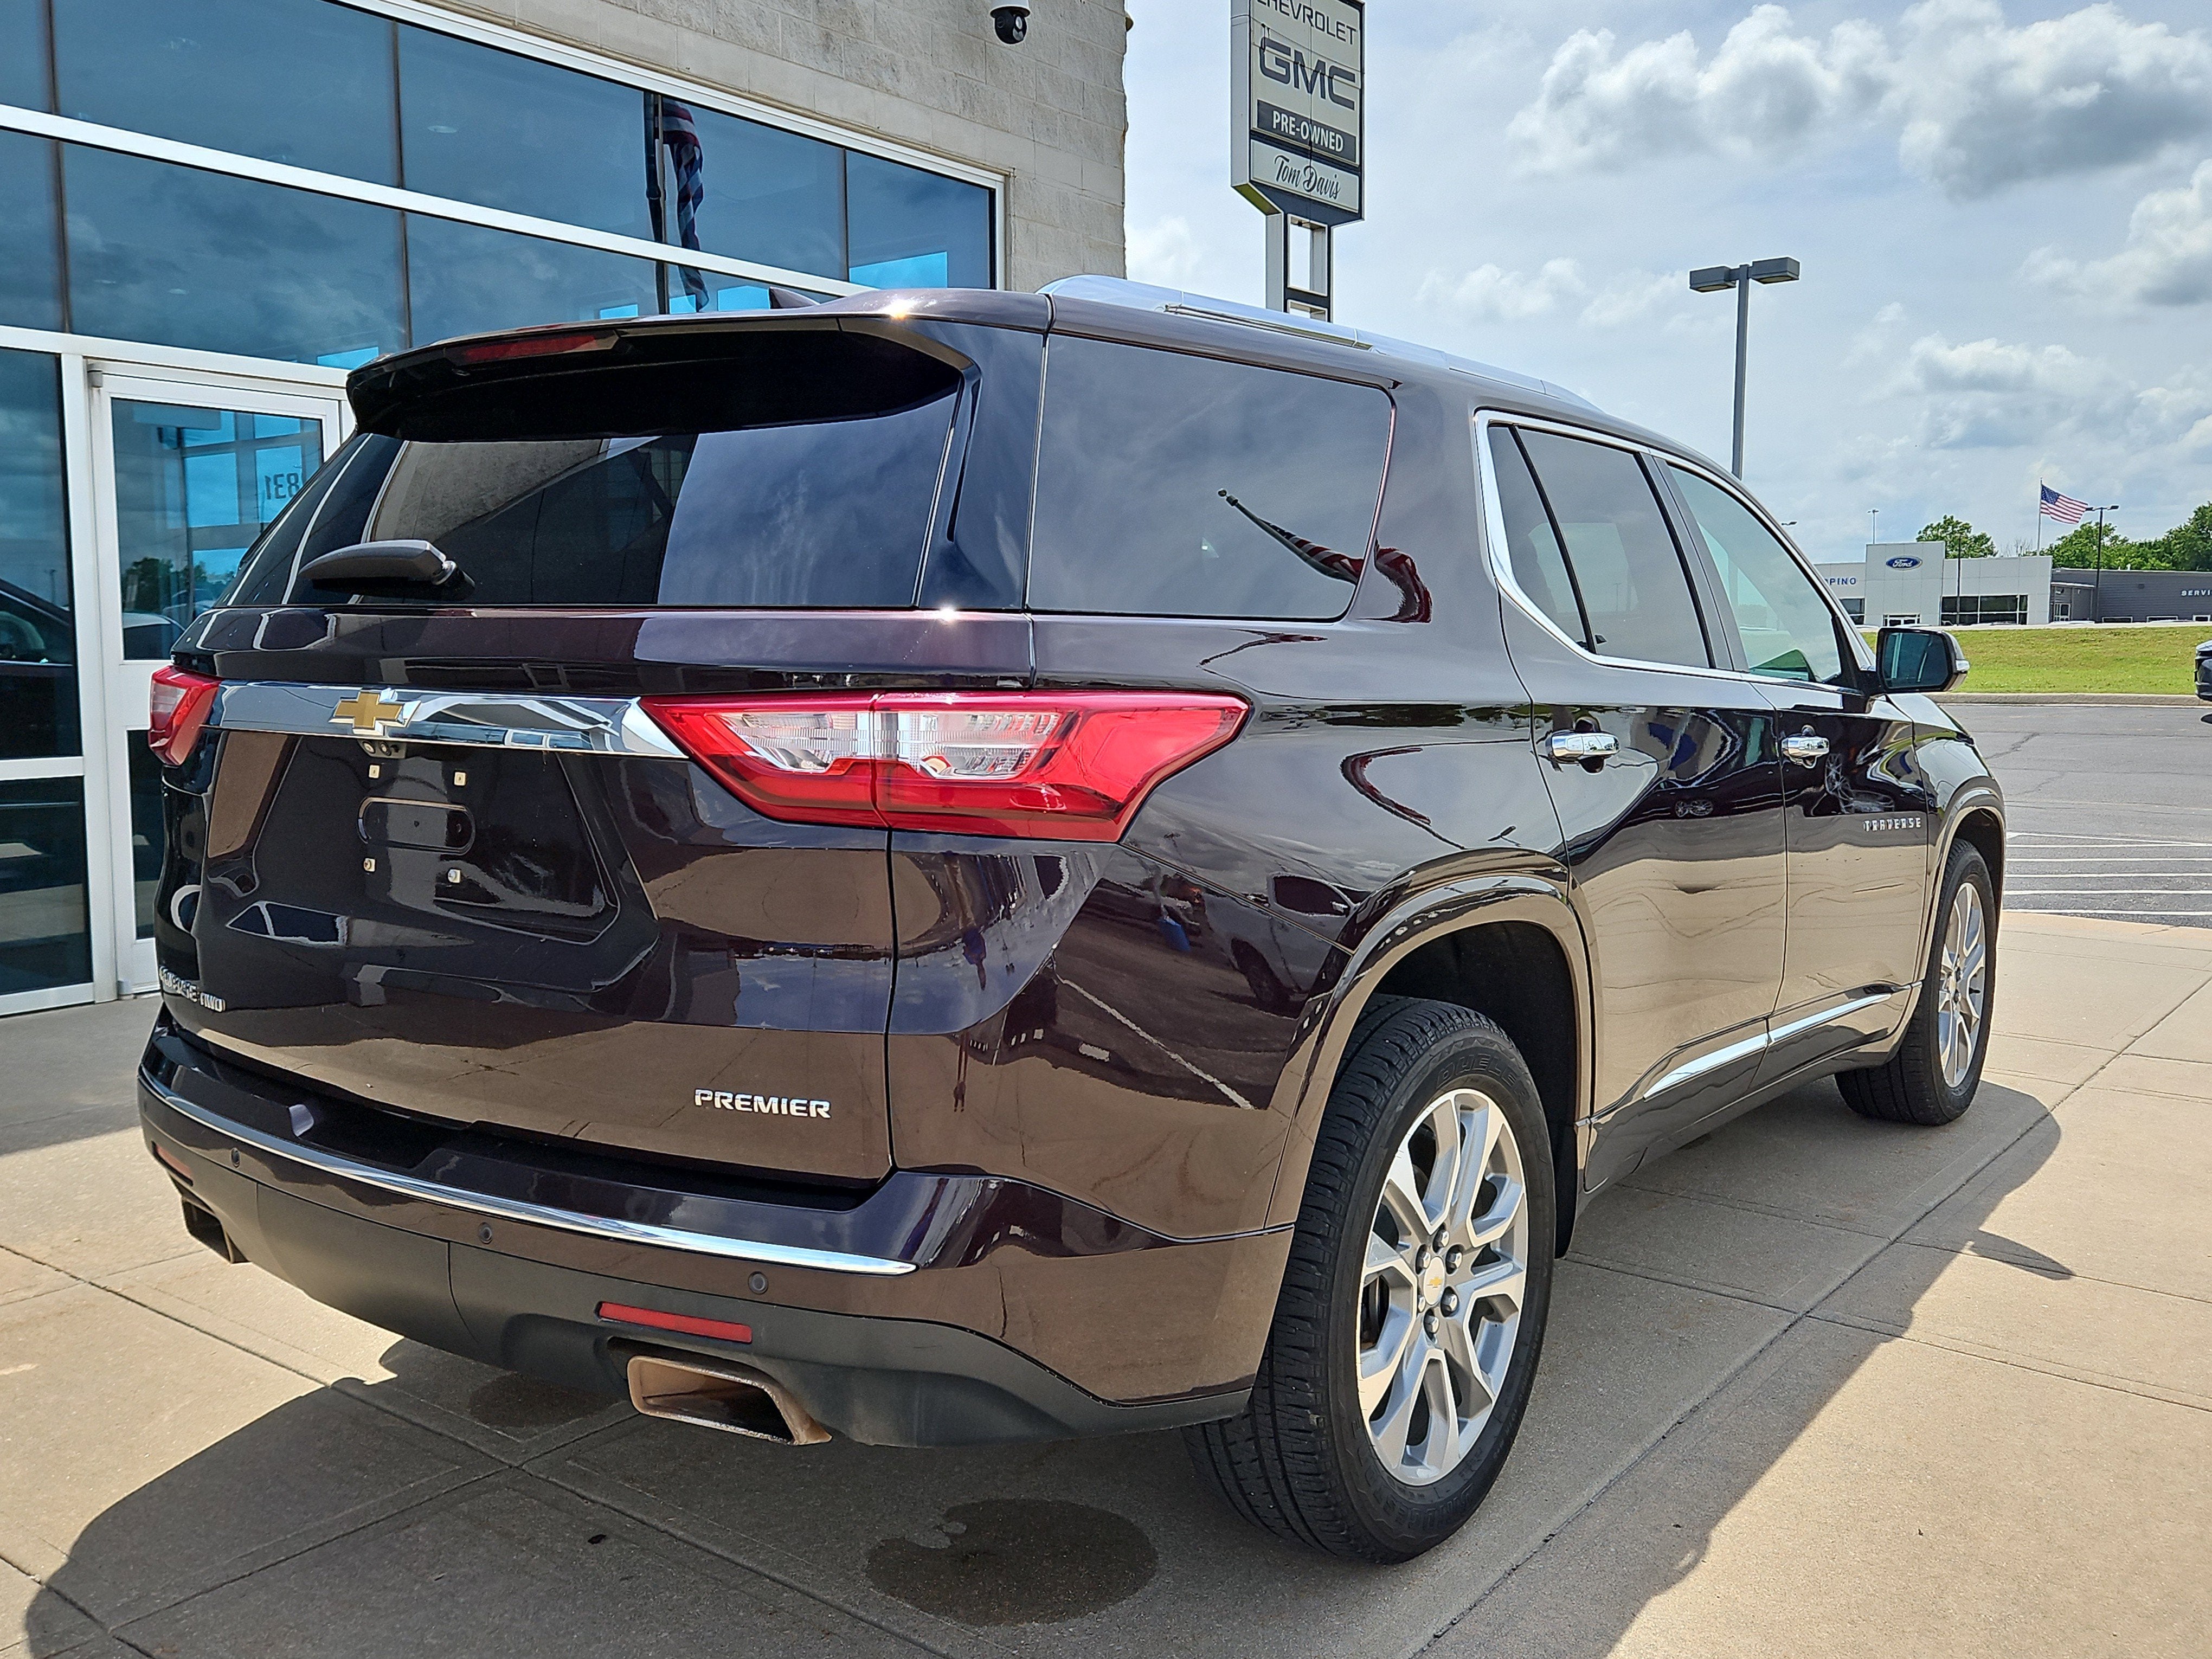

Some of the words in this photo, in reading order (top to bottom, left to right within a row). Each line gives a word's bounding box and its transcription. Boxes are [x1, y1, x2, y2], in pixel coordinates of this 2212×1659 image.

[1256, 0, 1356, 44] HEVROLET
[1259, 37, 1355, 111] GMC
[1272, 111, 1344, 152] PRE-OWNED
[1274, 155, 1301, 188] Tom
[1303, 165, 1341, 200] Davis
[1863, 817, 1921, 832] TRAVERSE
[1436, 1053, 1531, 1108] DUELER
[695, 1089, 832, 1118] PREMIER
